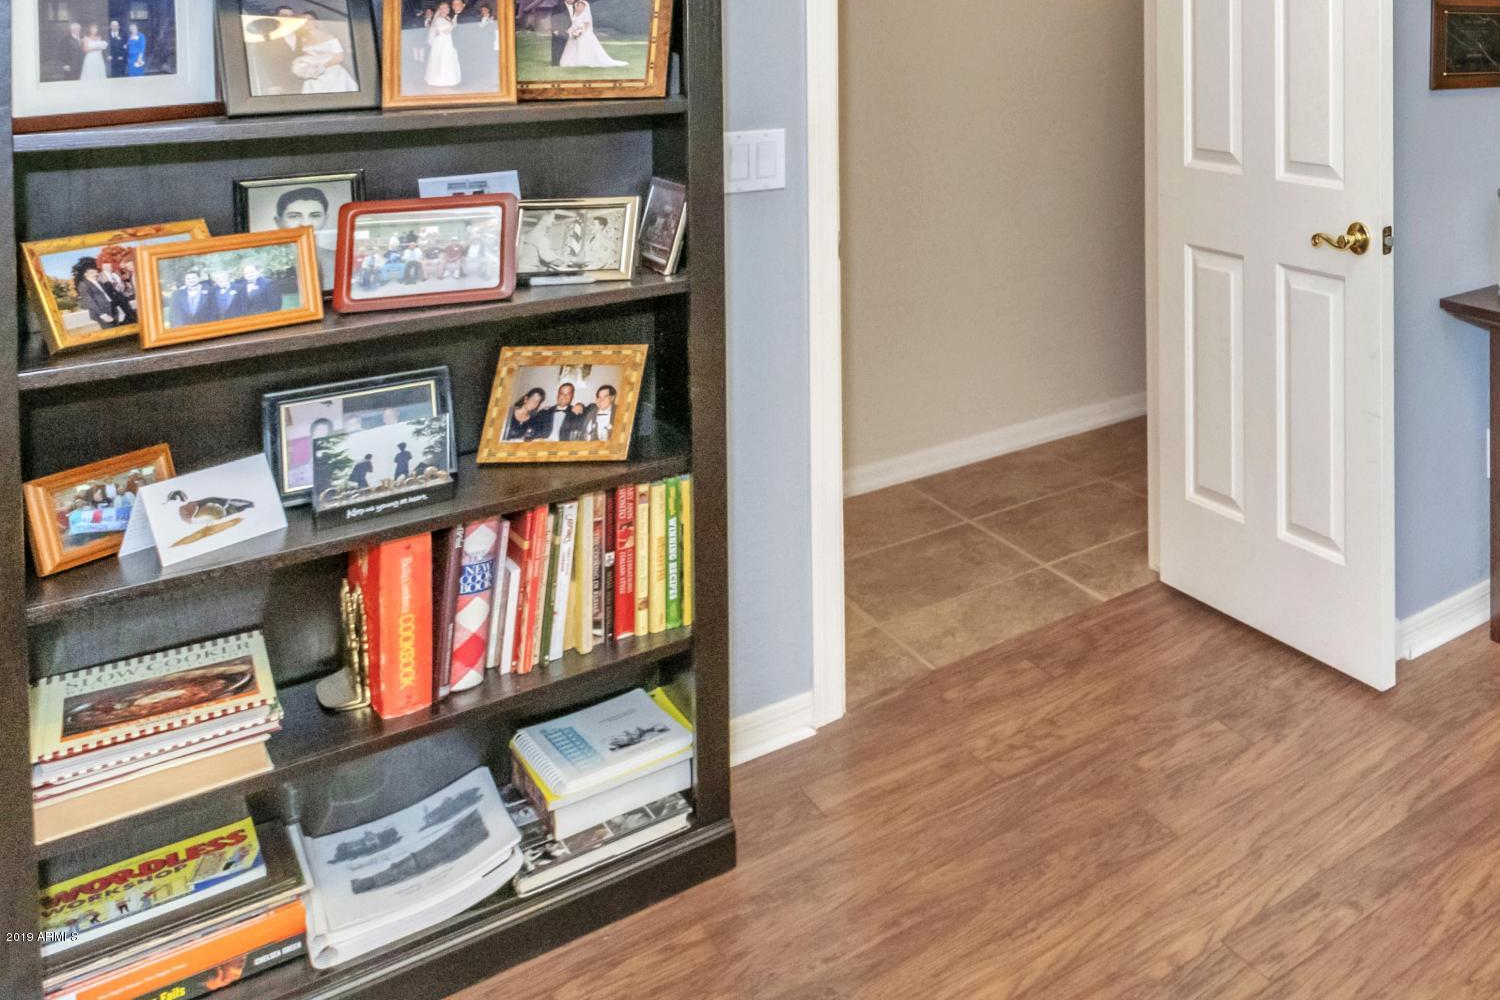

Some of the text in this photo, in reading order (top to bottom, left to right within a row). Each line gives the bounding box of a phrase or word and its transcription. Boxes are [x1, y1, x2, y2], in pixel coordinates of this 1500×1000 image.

[669, 516, 677, 561] WINNING
[459, 573, 492, 585] COOK
[459, 581, 491, 594] BOOK
[465, 561, 491, 576] NEW
[669, 562, 677, 600] RECIPES
[65, 666, 138, 690] SLOW
[145, 641, 250, 670] COOKER
[399, 614, 416, 690] COOKBOOK
[40, 829, 248, 910] WORDLESS
[41, 864, 188, 919] WORKSHOP
